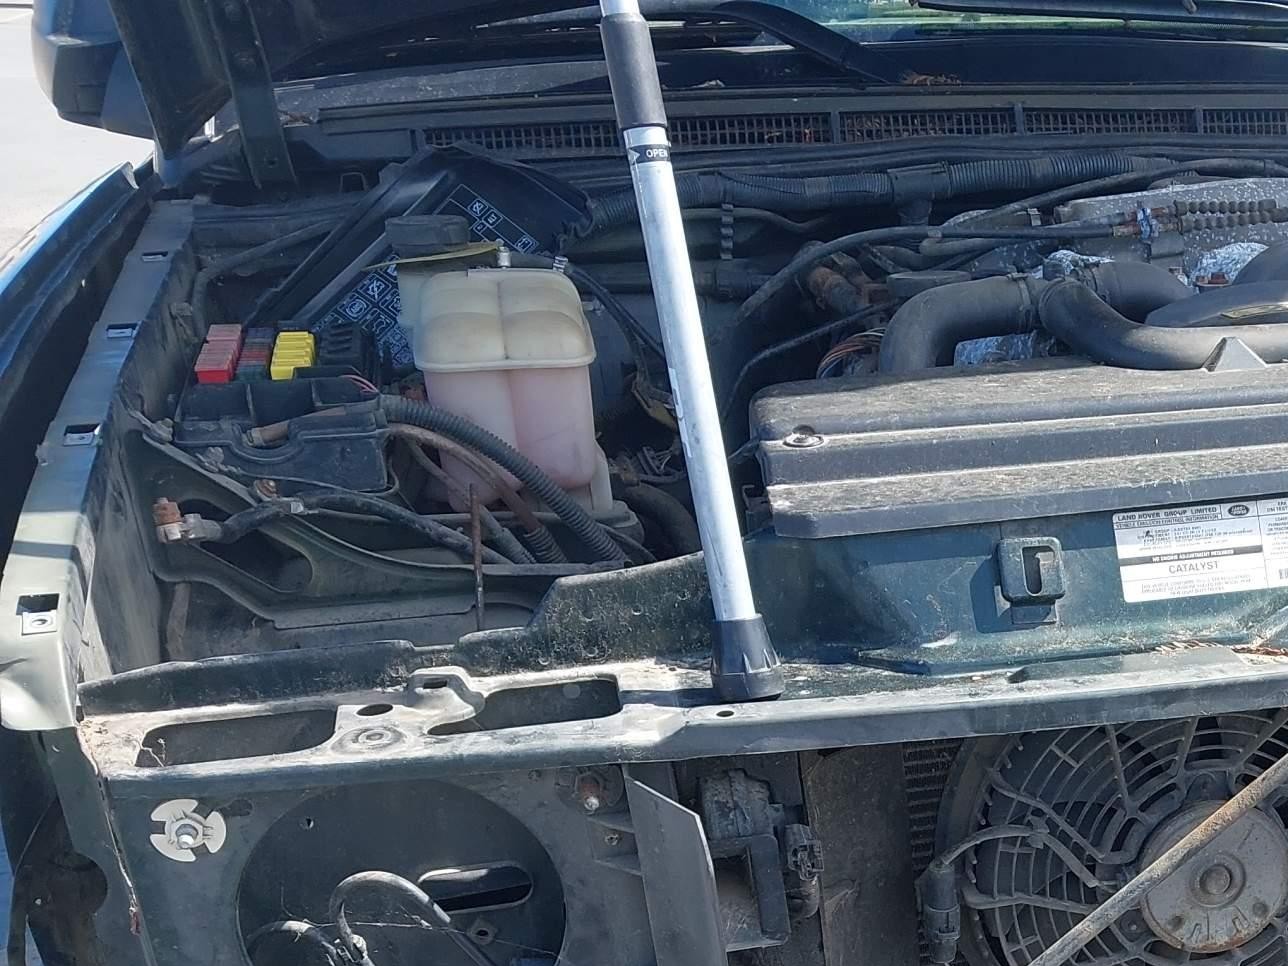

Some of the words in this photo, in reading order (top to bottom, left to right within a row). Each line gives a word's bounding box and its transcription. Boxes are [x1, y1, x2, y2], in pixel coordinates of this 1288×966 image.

[1138, 512, 1161, 520] ROVER
[1164, 509, 1188, 517] GROUP
[1190, 507, 1217, 515] LIMITED
[1168, 560, 1219, 574] CATALYST
